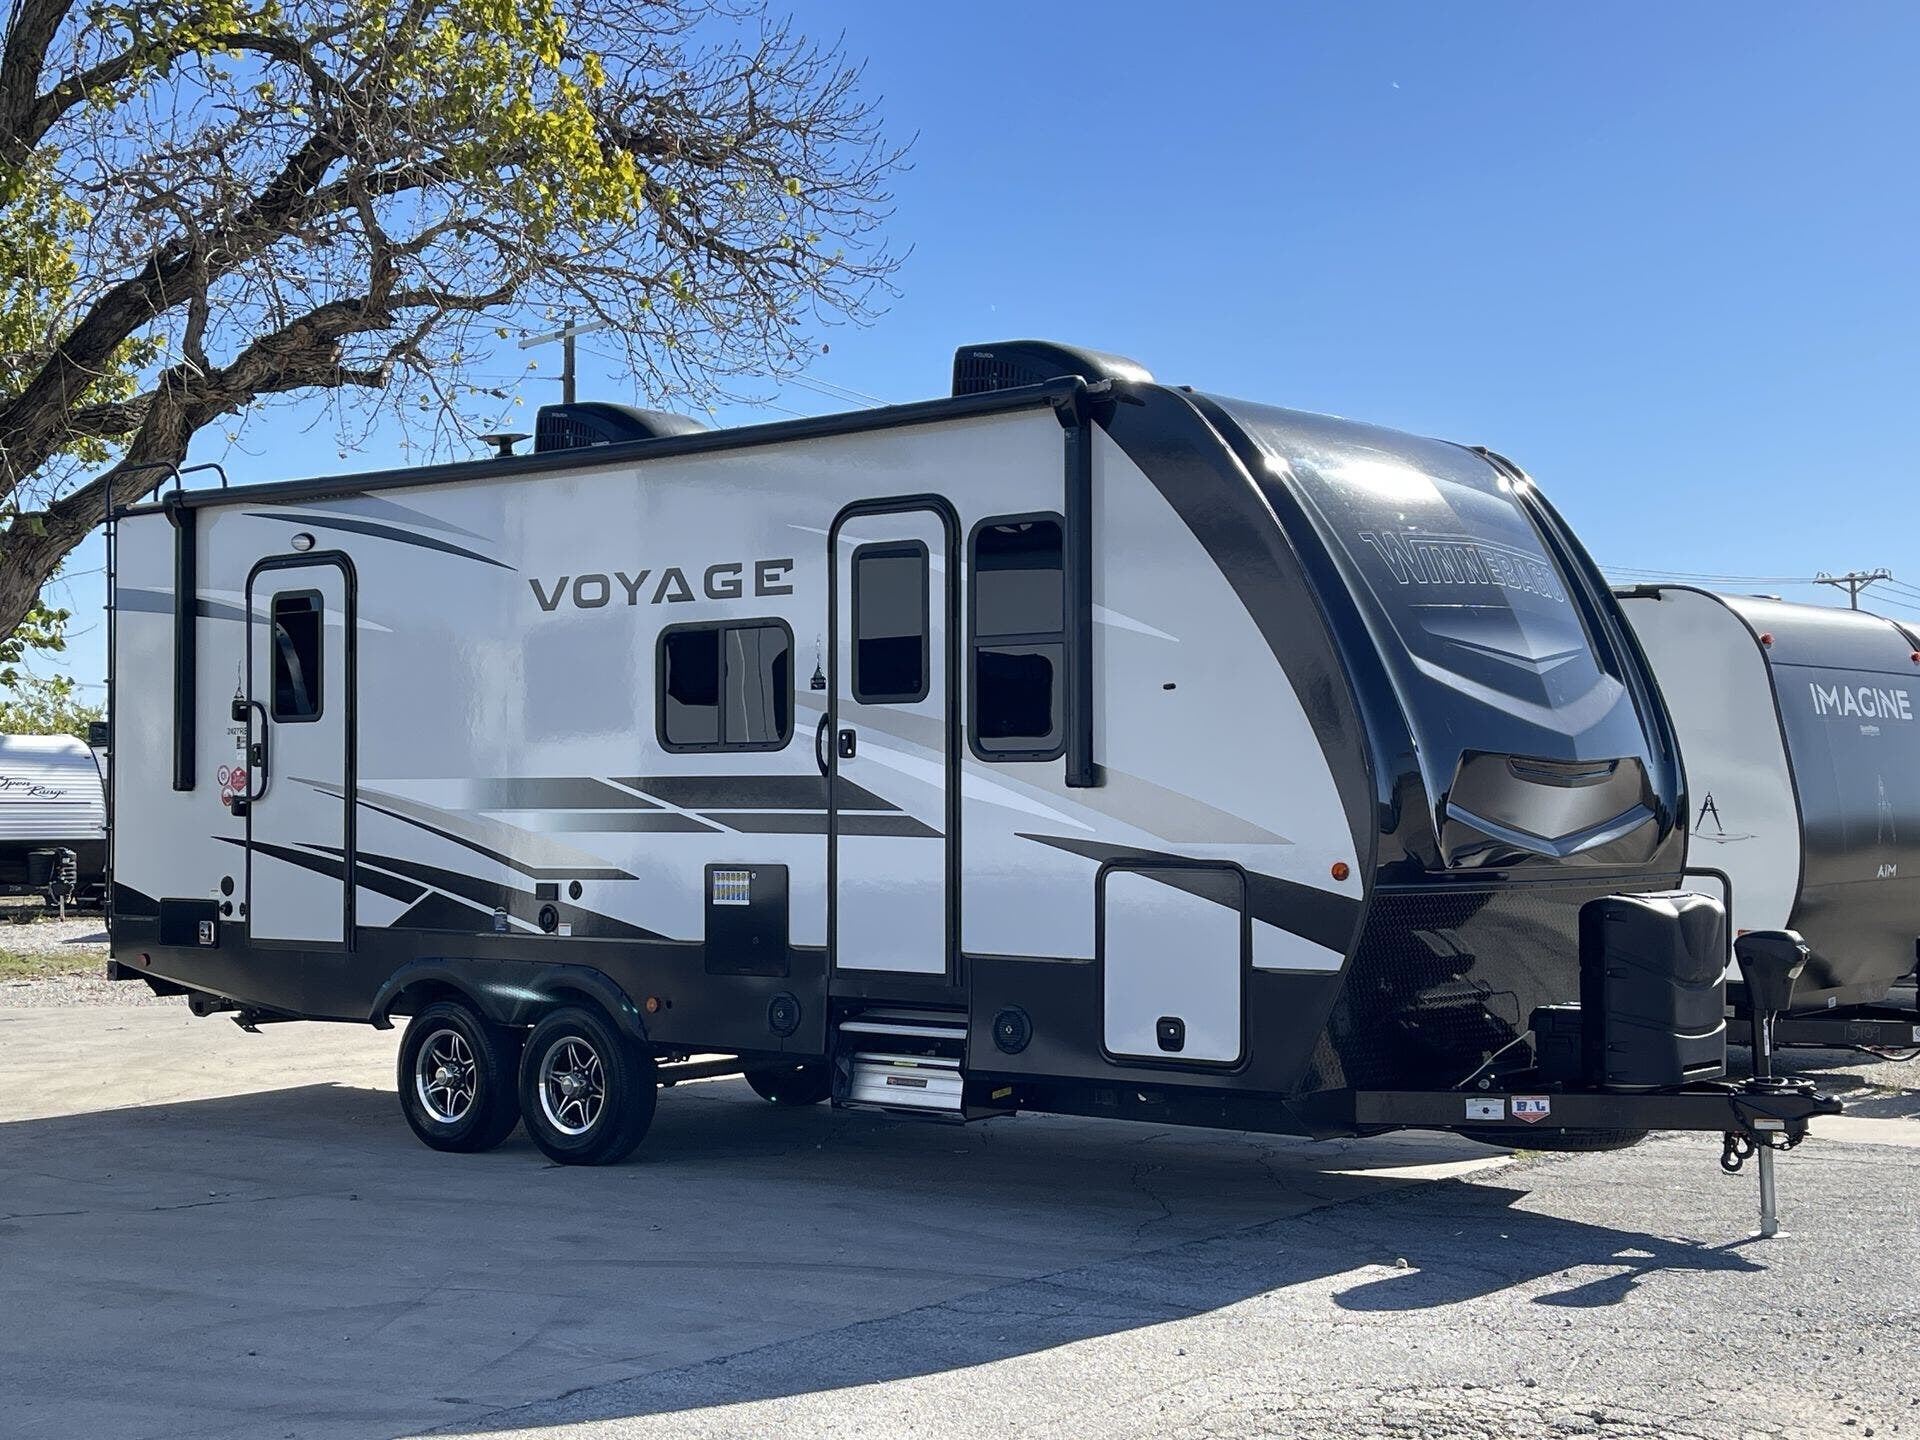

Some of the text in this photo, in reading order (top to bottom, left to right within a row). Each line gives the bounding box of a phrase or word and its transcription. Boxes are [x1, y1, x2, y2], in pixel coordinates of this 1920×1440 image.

[528, 558, 793, 611] VOYAGE
[1358, 531, 1564, 602] WINNEBAGO
[1809, 683, 1913, 720] IMAGINE
[1877, 864, 1897, 878] AIM
